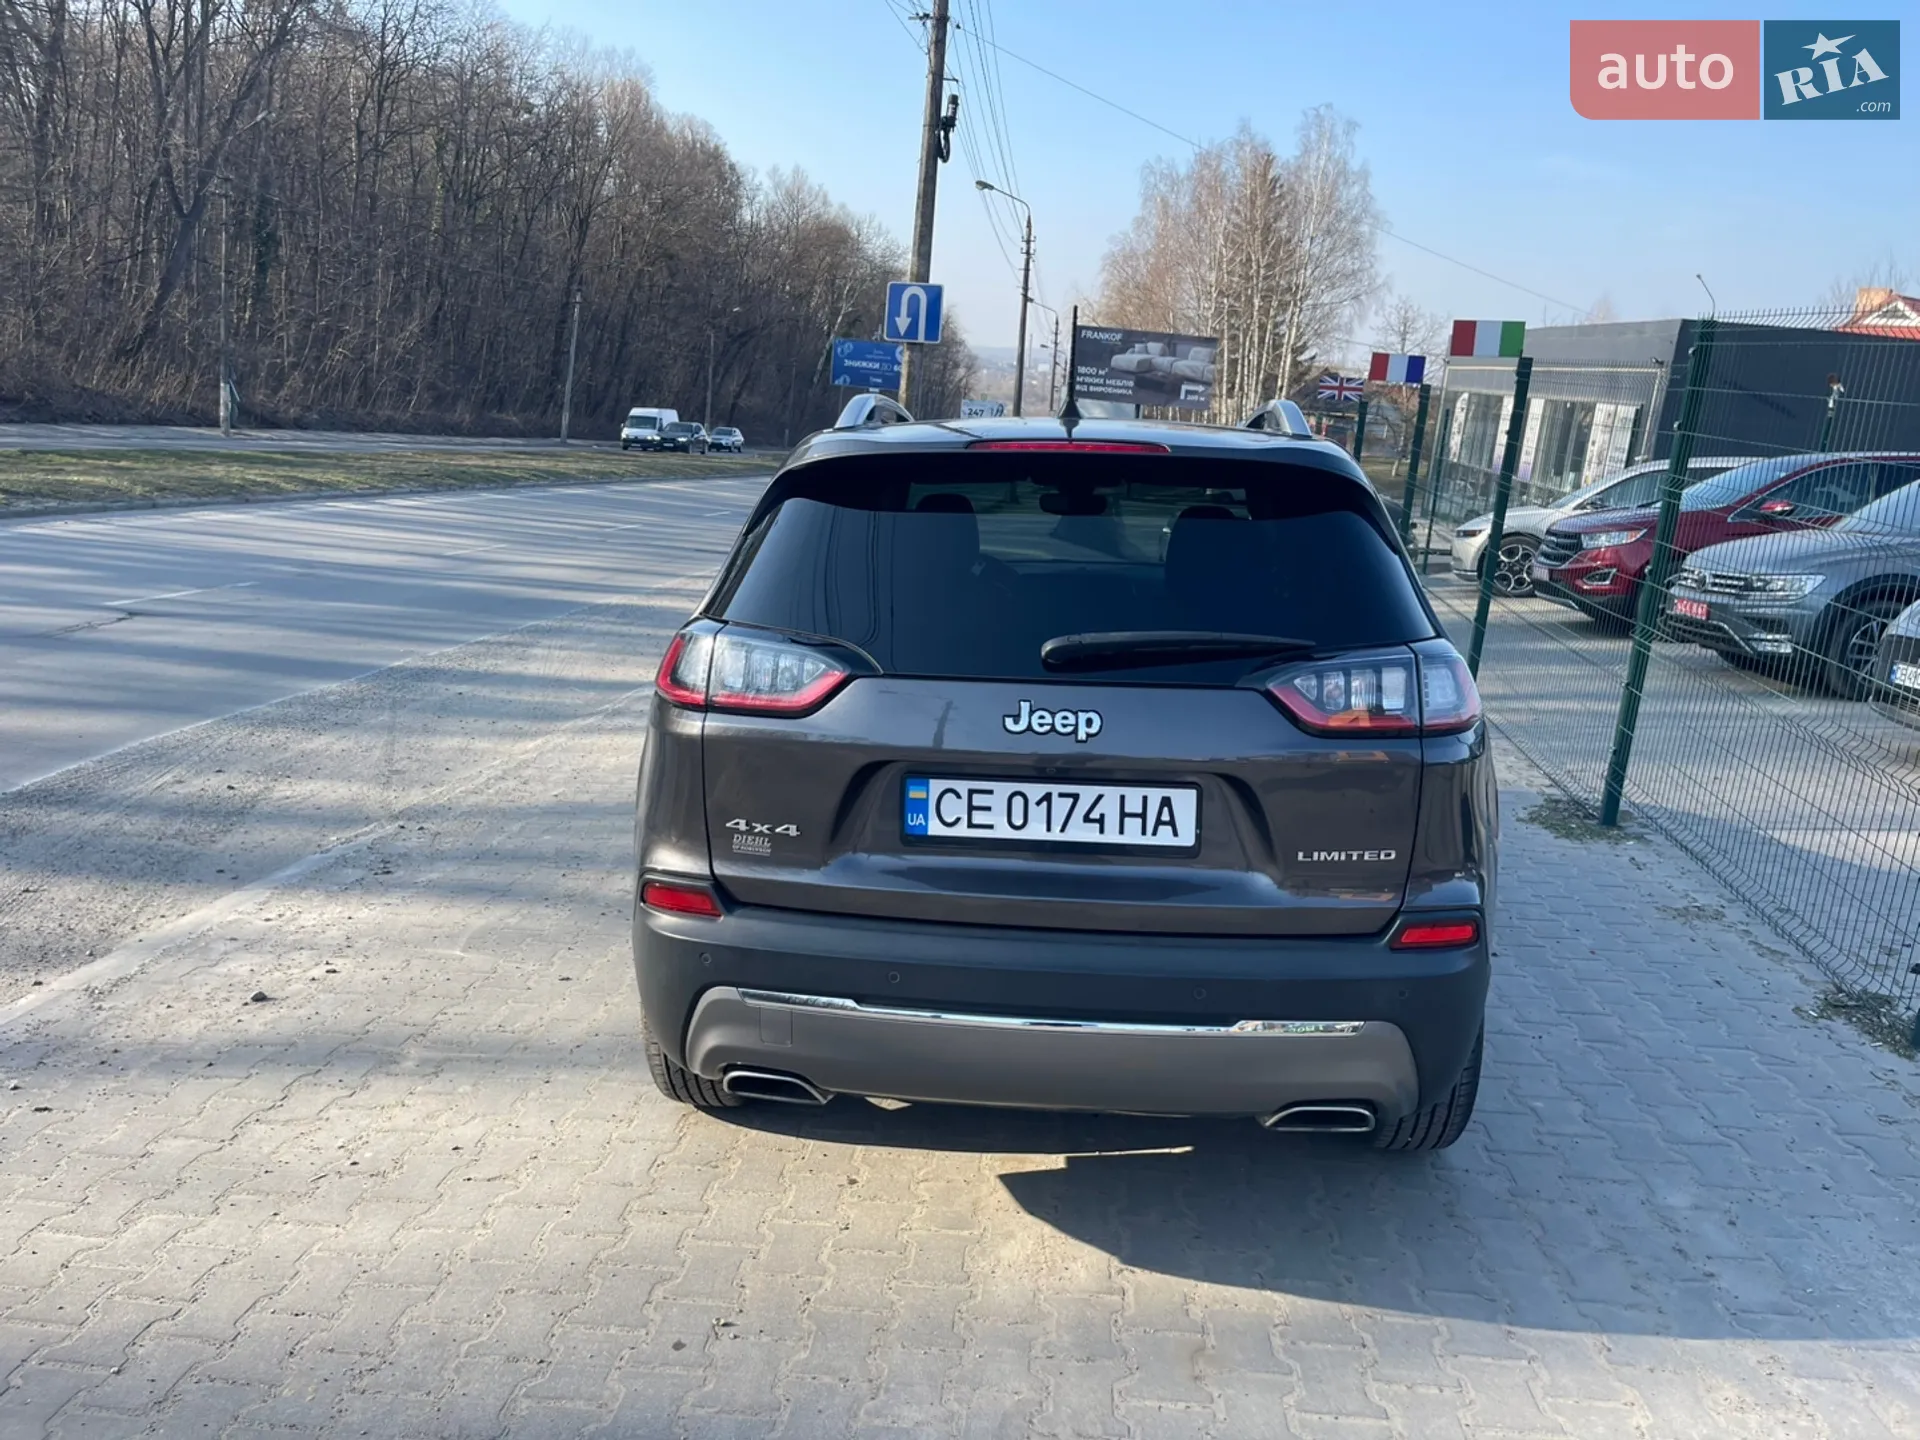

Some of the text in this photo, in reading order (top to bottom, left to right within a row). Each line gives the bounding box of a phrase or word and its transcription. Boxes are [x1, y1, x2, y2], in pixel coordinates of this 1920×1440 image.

[1081, 329, 1123, 341] FRANKOF
[844, 359, 880, 370] ЗНИЖКИ
[1002, 700, 1102, 742] Jeep
[935, 787, 1179, 837] CE 0174 HA
[908, 813, 925, 827] UA
[725, 819, 800, 836] 4x4
[732, 833, 772, 847] DIEHL
[1297, 849, 1397, 862] LIMITED
